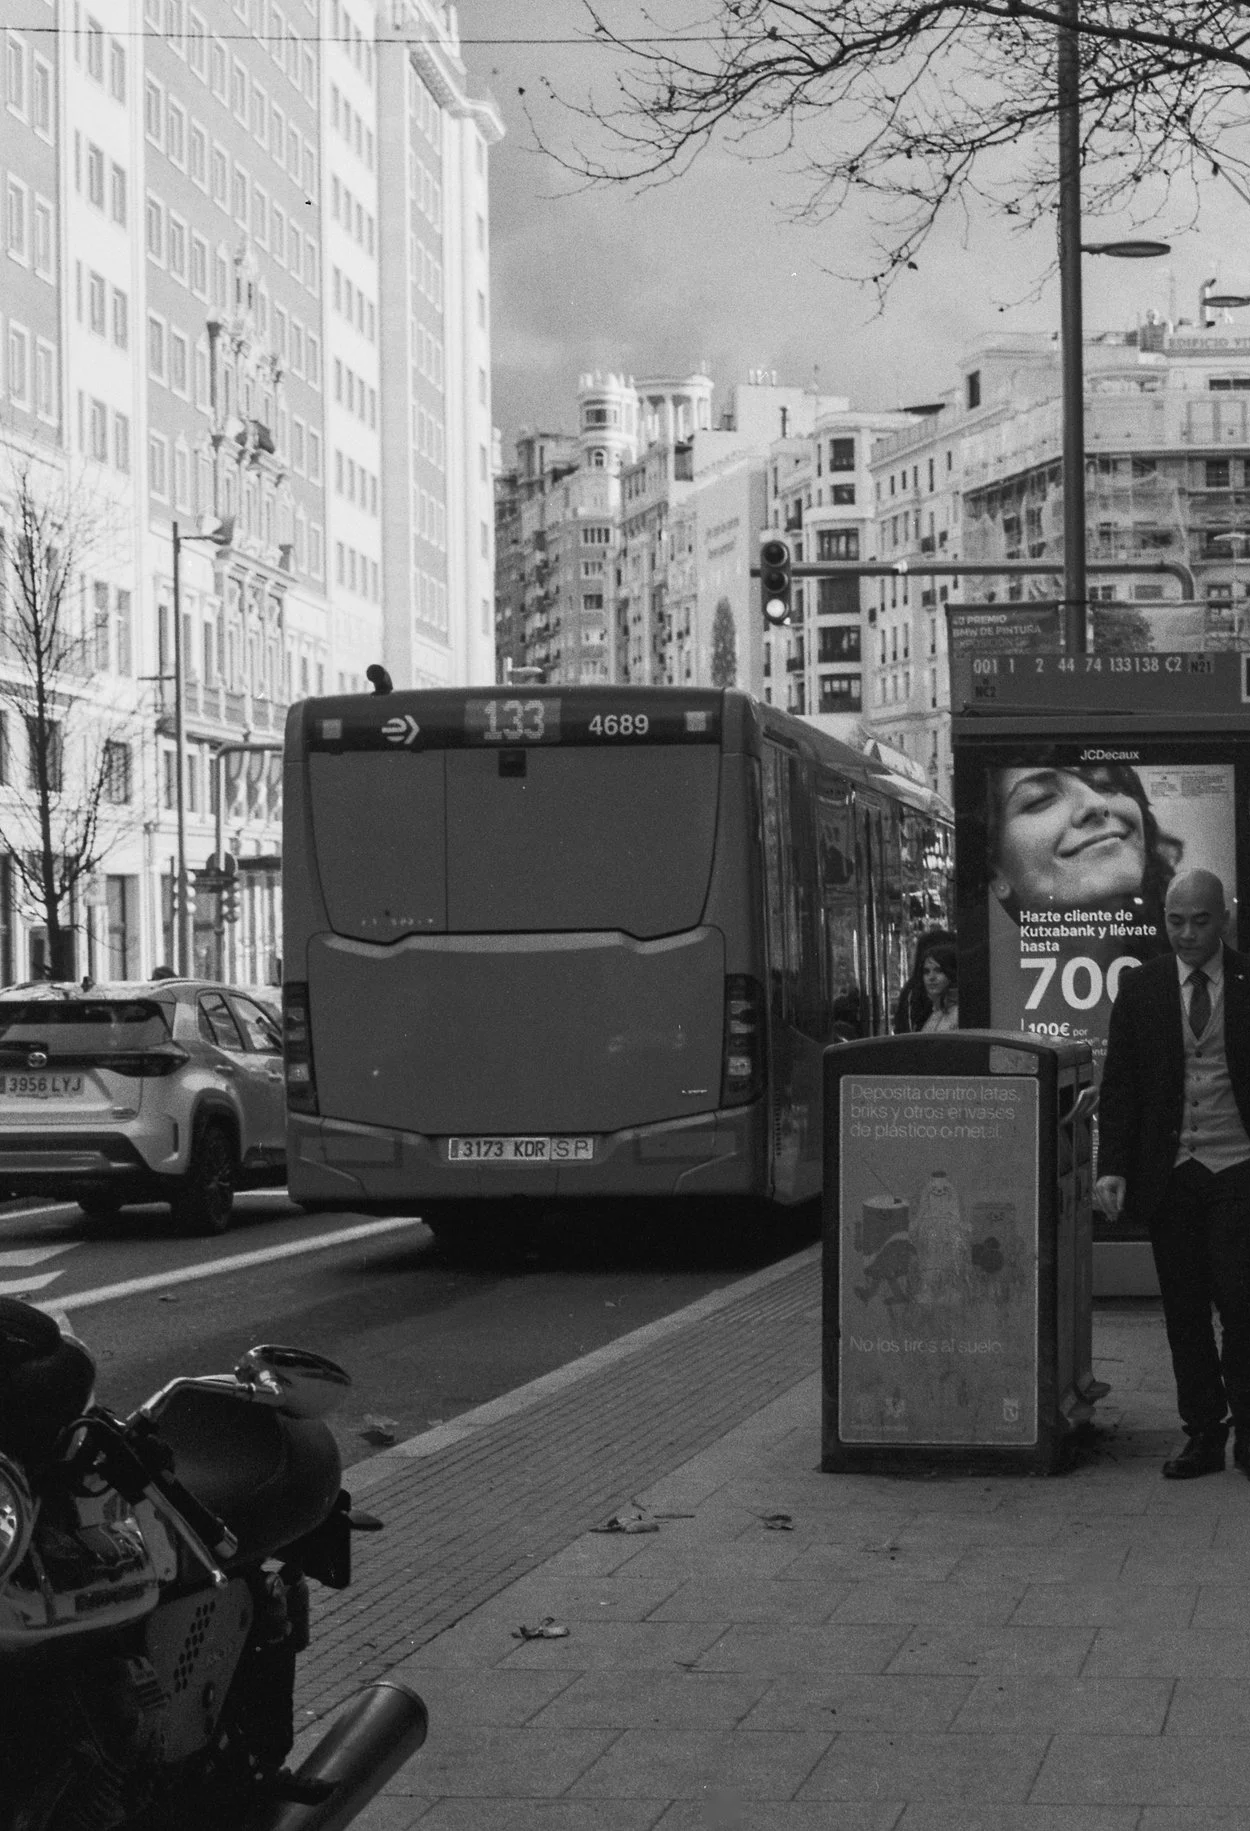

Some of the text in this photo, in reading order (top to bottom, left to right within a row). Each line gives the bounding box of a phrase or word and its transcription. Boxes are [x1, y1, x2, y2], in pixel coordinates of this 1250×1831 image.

[1168, 337, 1229, 349] EDIFICIO
[967, 614, 1007, 625] PREMIO
[980, 626, 994, 636] DE
[995, 624, 1042, 635] PINTURA
[973, 658, 998, 674] 001
[1009, 658, 1015, 673] 1
[1035, 658, 1045, 673] 2
[1058, 657, 1076, 672] 44
[1085, 658, 1102, 672] 74
[1109, 658, 1132, 672] 133
[1134, 658, 1159, 672] 138
[1190, 661, 1212, 674] N21
[975, 686, 997, 698] NC2
[484, 699, 545, 740] 133
[588, 713, 650, 736] 4689
[1080, 749, 1140, 761] JCDecaux
[1020, 909, 1133, 923] Hazte cliente de
[1020, 923, 1158, 940] Kutxabank y llévate
[1020, 940, 1060, 953] hasta
[1028, 1022, 1089, 1038] 100€ por
[9, 1077, 82, 1092] 3956 LYJ
[850, 1083, 921, 1102] Deposita
[924, 1084, 977, 1101] dentro
[850, 1103, 1016, 1125] briks y otros envases
[850, 1121, 872, 1138] de
[875, 1121, 937, 1141] plástico
[940, 1126, 953, 1138] o
[463, 1140, 504, 1158] 3173
[513, 1140, 547, 1157] KDR
[850, 1335, 874, 1353] No
[877, 1337, 900, 1353] los
[904, 1338, 938, 1353] tires
[941, 1337, 955, 1353] al
